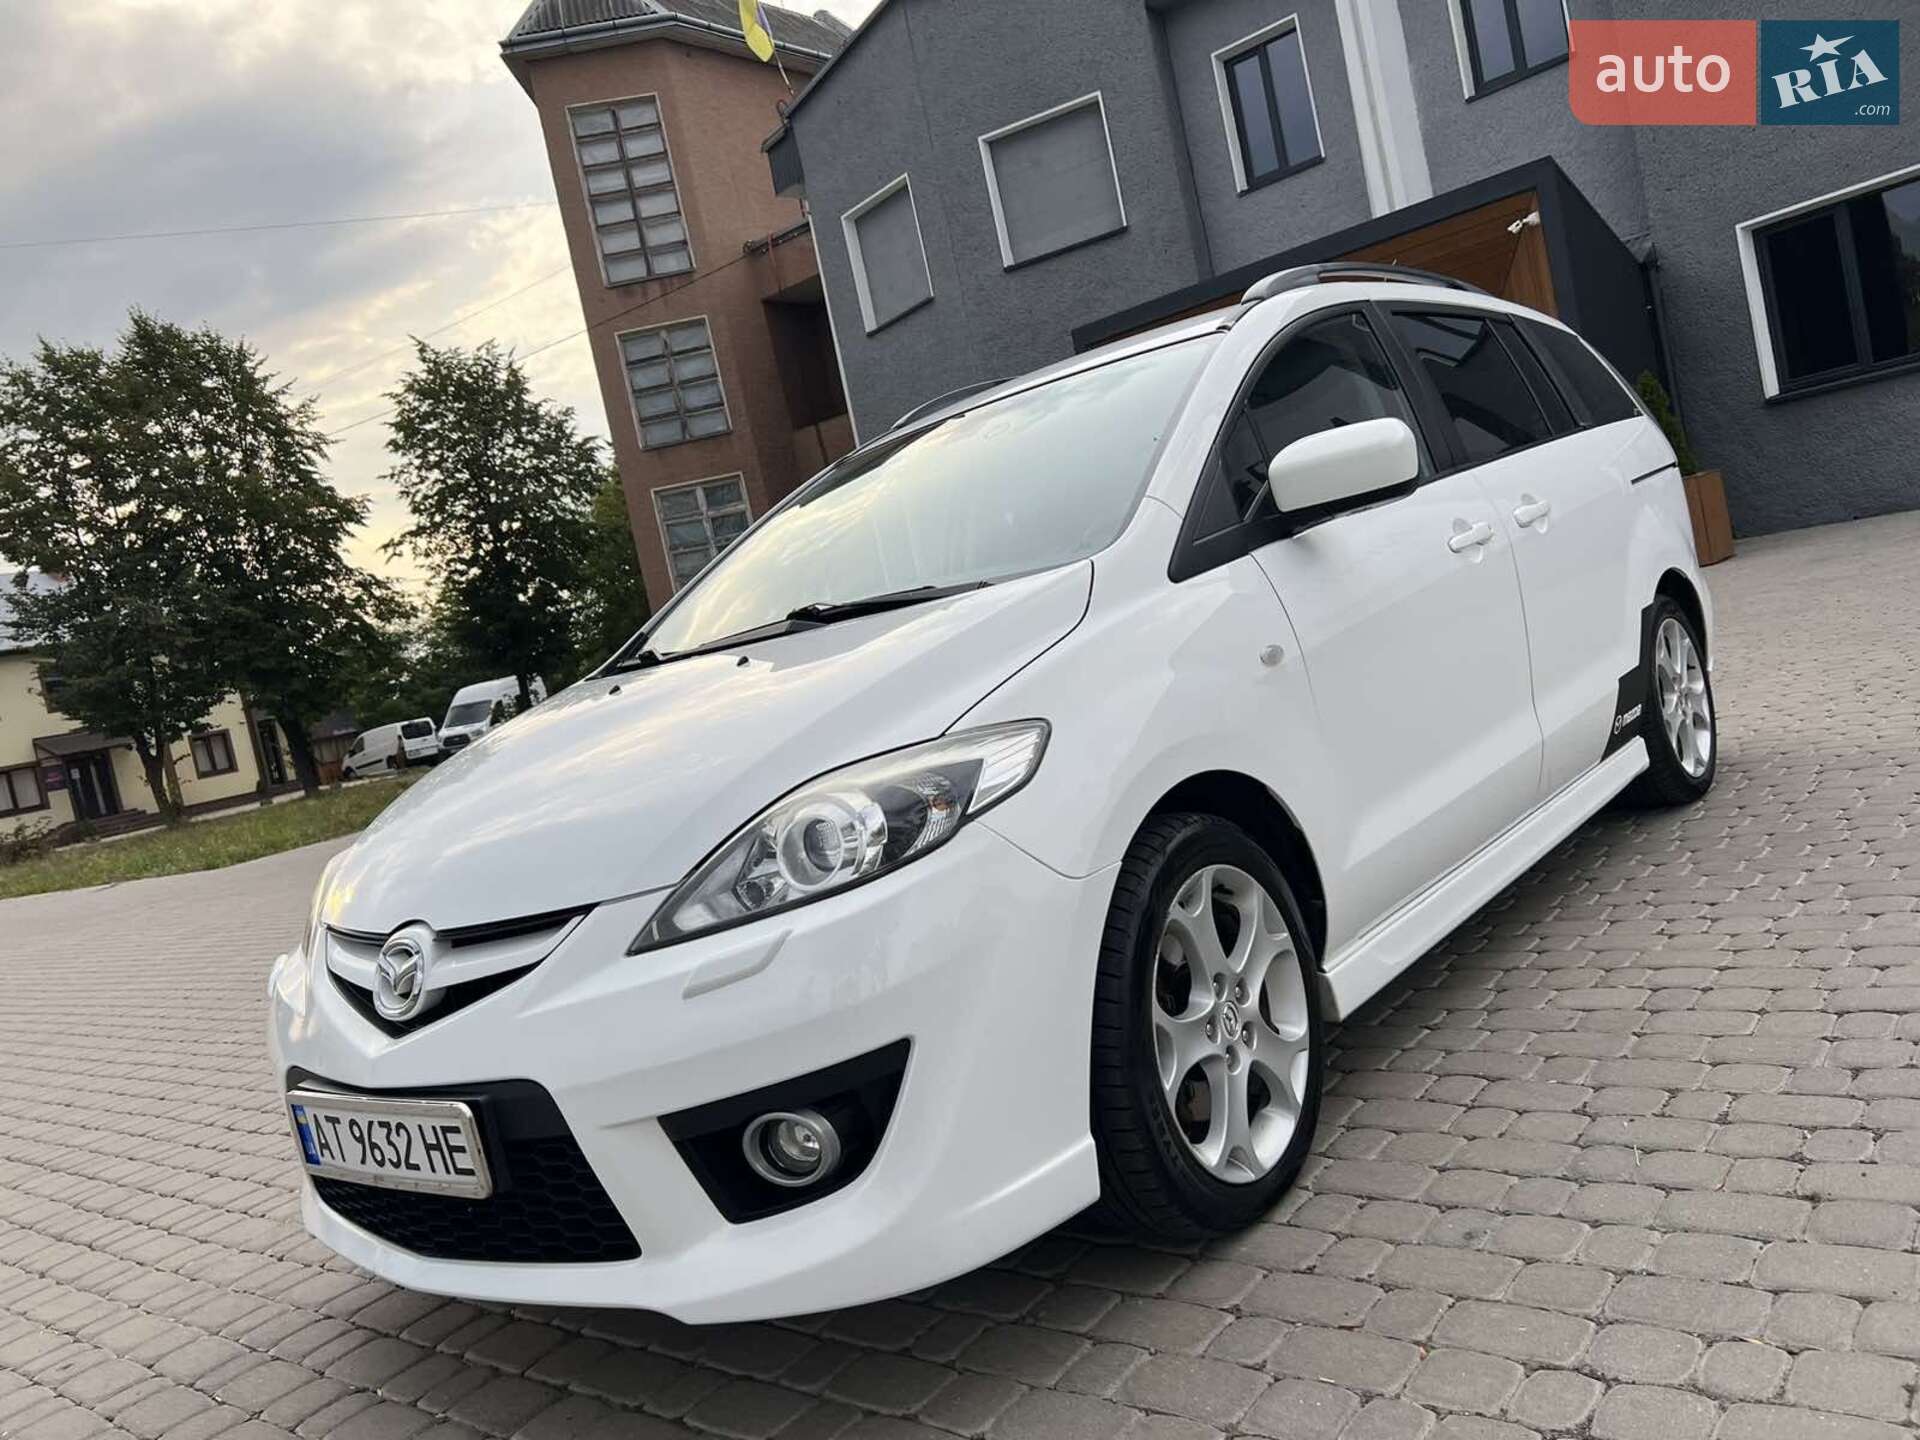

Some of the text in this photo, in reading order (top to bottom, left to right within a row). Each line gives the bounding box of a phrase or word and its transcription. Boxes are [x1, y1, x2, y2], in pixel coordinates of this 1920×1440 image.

[313, 1112, 476, 1176] AT 9632 HE
